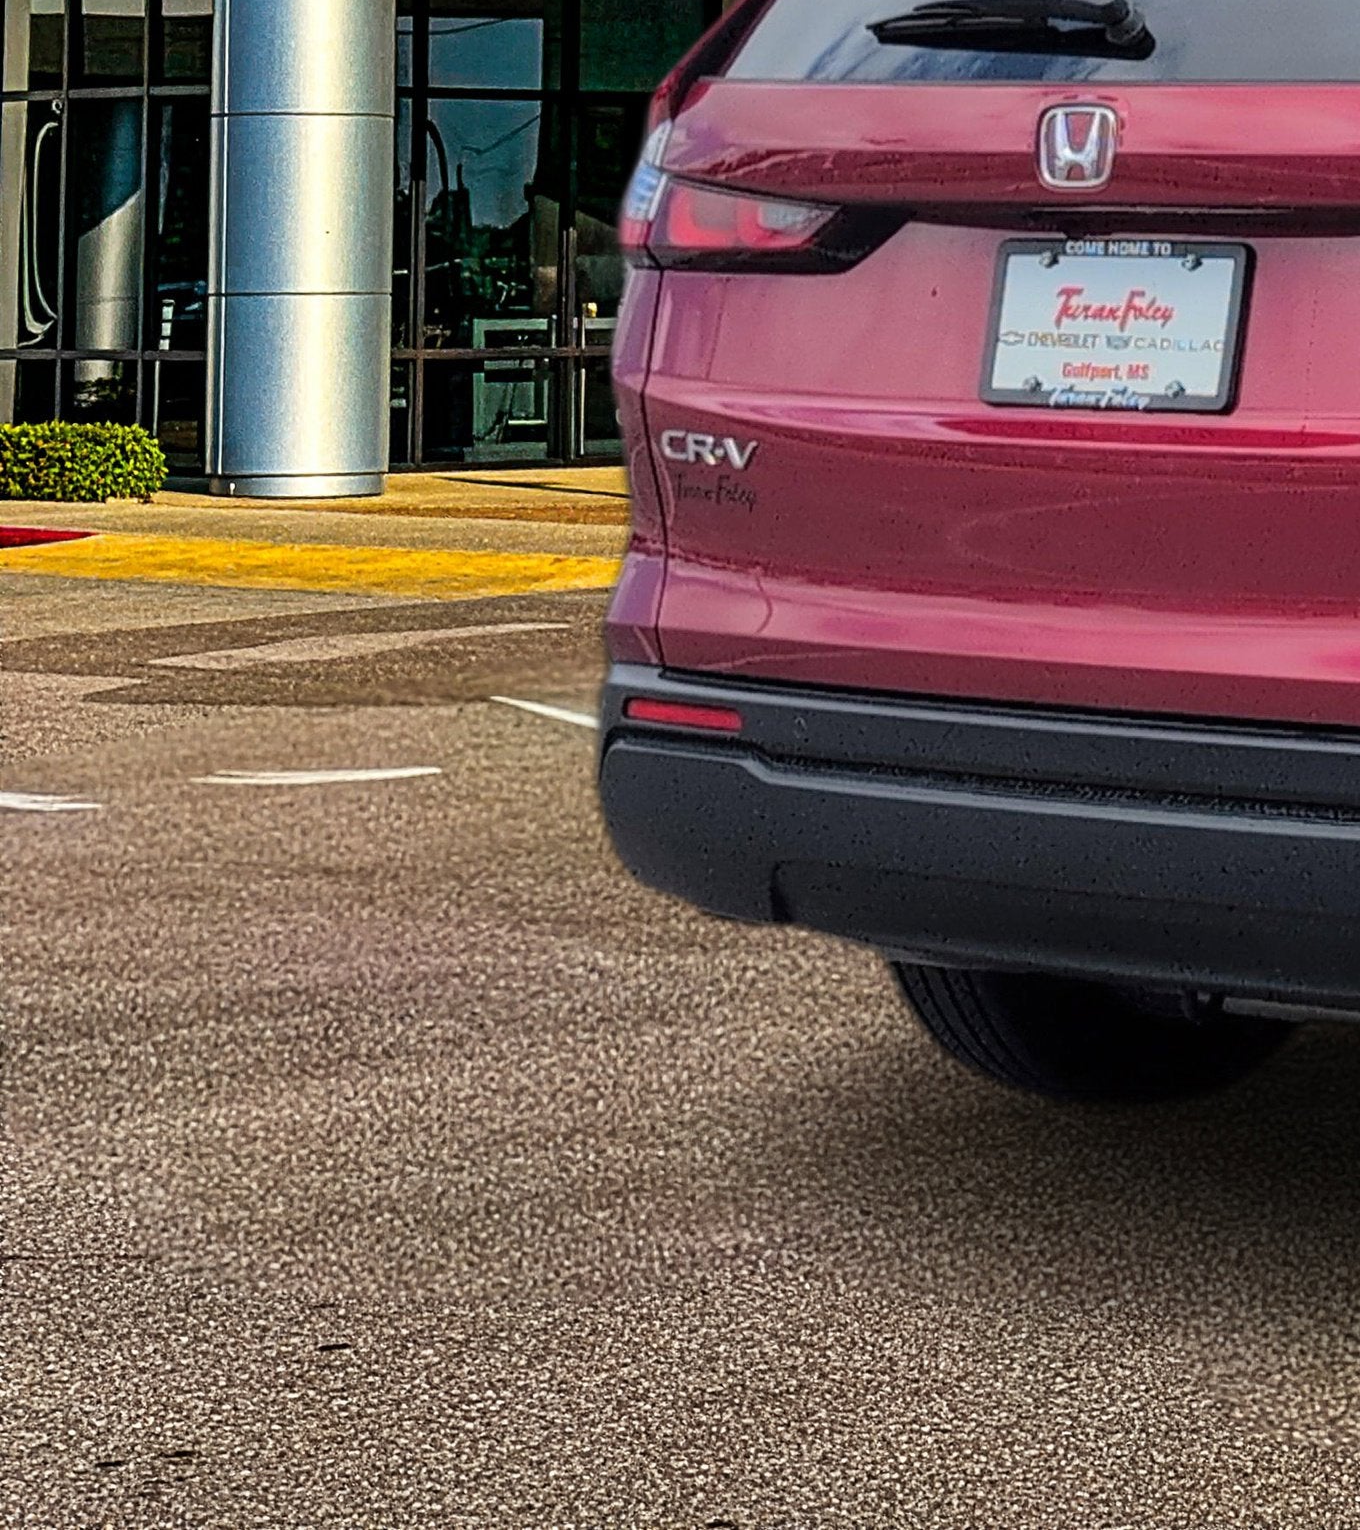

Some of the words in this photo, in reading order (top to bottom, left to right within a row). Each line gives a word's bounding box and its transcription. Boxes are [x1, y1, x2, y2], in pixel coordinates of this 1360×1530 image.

[1065, 240, 1105, 255] COME
[1108, 241, 1149, 256] HOME
[1152, 242, 1172, 256] TO
[1027, 332, 1099, 350] CHEVROLET
[1133, 336, 1224, 352] CADILLAC
[1062, 362, 1120, 381] Gulfport,
[1126, 364, 1149, 379] MS
[661, 429, 758, 470] CR-V
